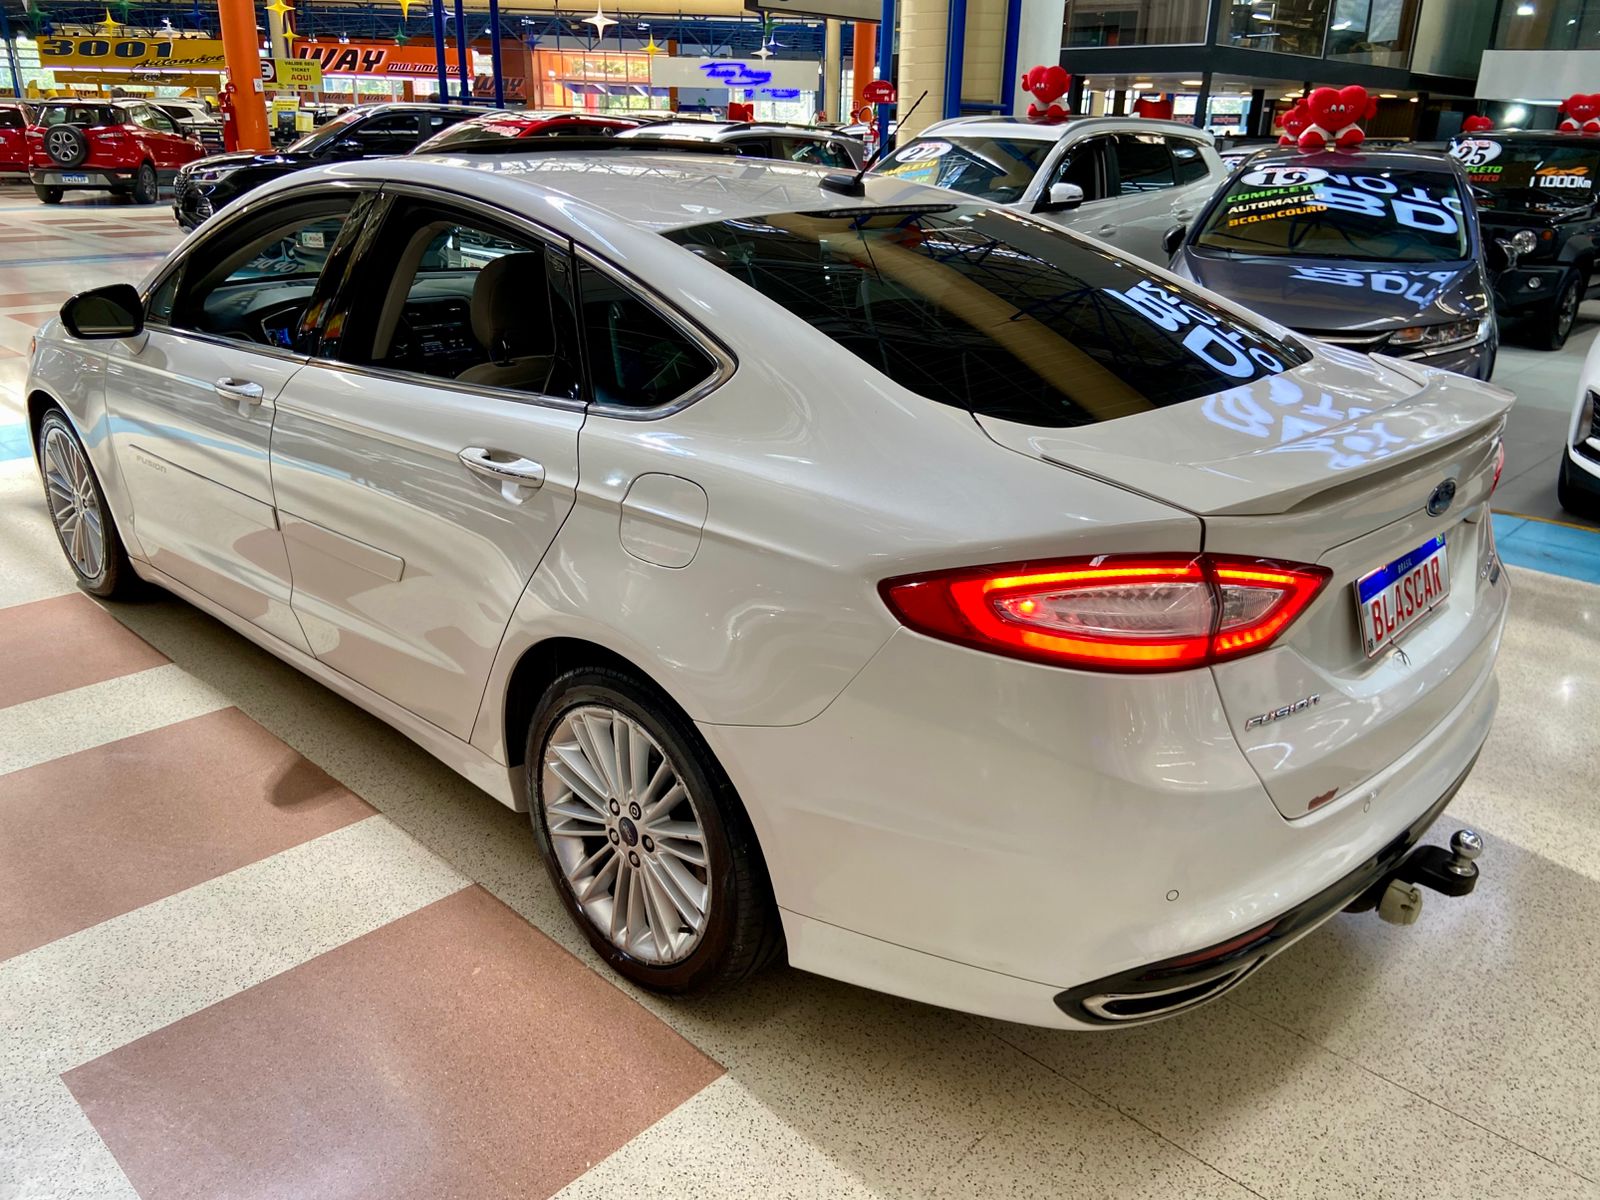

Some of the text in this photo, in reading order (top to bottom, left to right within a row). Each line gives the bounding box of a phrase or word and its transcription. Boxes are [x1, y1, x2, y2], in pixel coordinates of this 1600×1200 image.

[42, 39, 173, 58] 3001
[901, 147, 941, 161] 22
[1458, 146, 1490, 165] 25
[1258, 171, 1309, 185] 19
[1227, 183, 1325, 203] COMPLETO
[1227, 193, 1326, 214] AUTOMATICO
[1261, 213, 1276, 221] EM
[1276, 205, 1328, 218] COURO
[1397, 558, 1413, 574] BRASIL
[1370, 556, 1442, 642] BLASCAR
